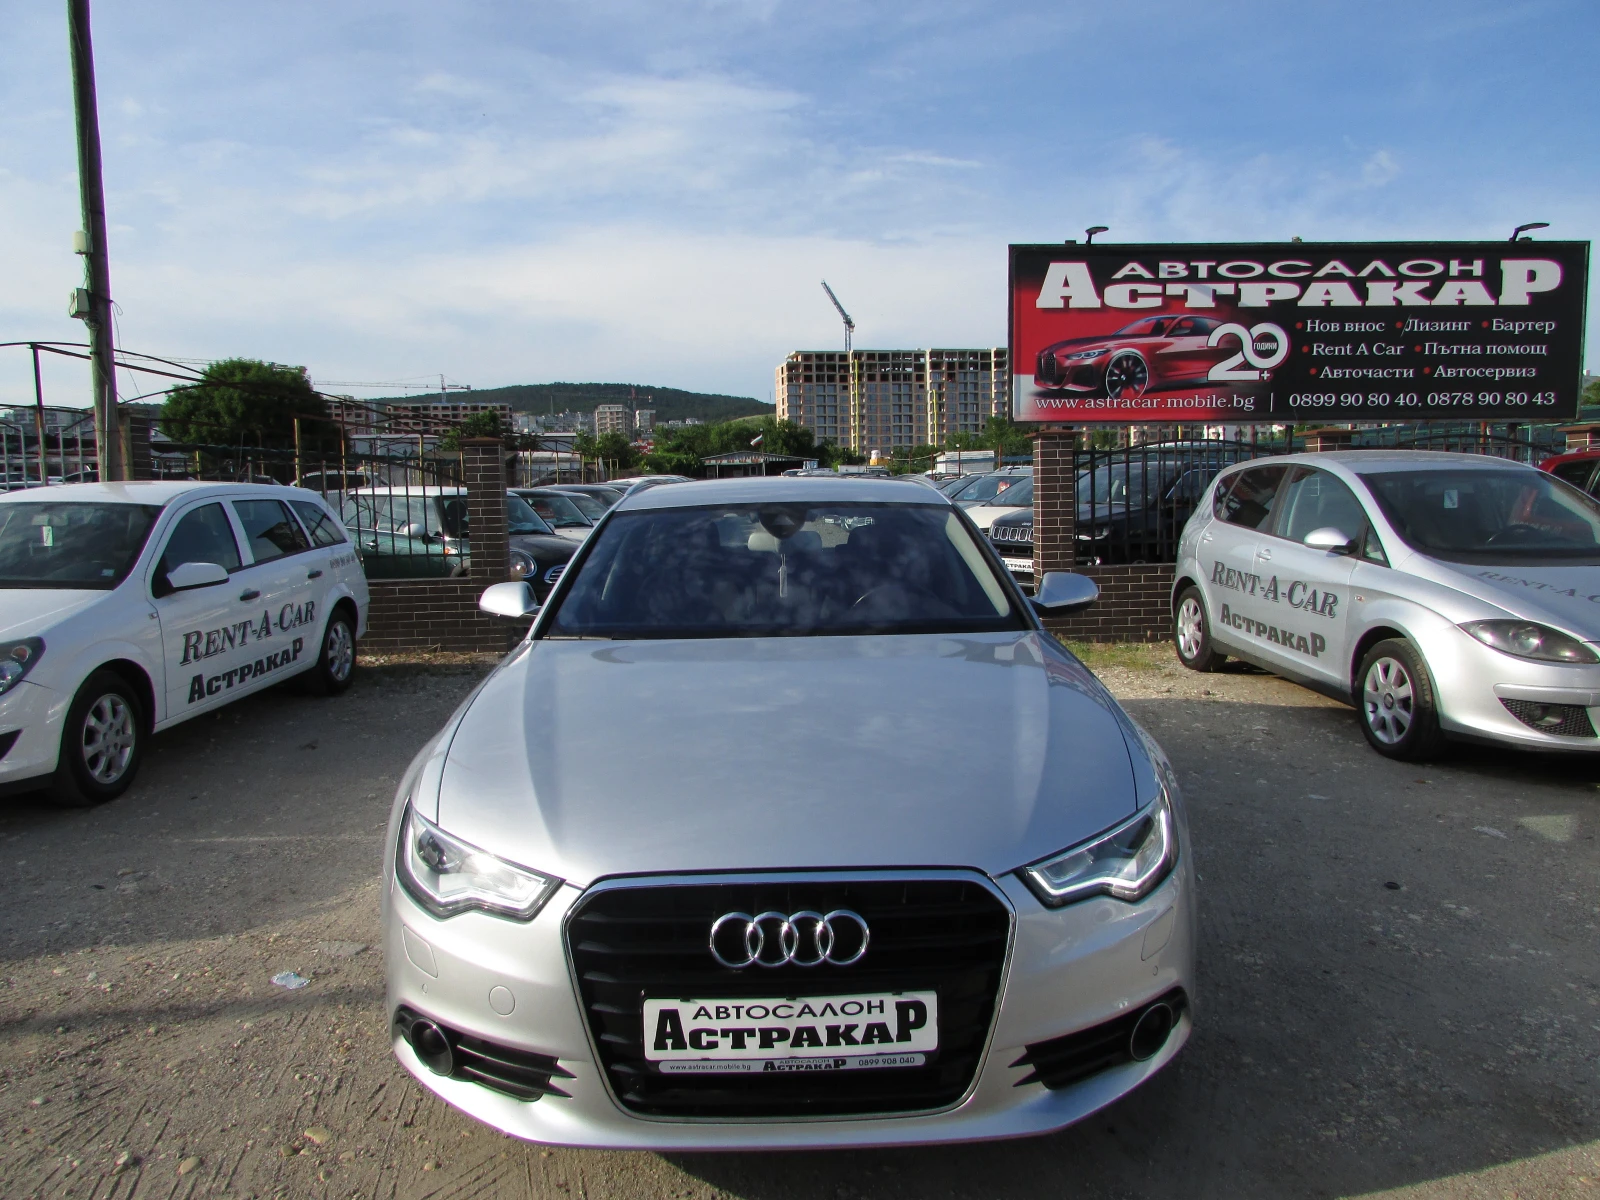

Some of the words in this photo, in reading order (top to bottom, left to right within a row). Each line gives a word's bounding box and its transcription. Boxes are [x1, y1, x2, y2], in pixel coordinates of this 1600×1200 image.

[1111, 260, 1483, 279] АВТОСАЛОН
[1305, 319, 1340, 332] Нов
[1344, 321, 1385, 332] внос
[1404, 319, 1471, 332] Лизинг
[1491, 318, 1555, 334] Бартер
[1311, 343, 1353, 356] Rent
[1355, 343, 1370, 355] A
[1372, 343, 1404, 355] Car
[1423, 343, 1482, 355] Пътна
[1484, 345, 1547, 357] помощ
[1319, 366, 1415, 378] Авточасти
[1433, 365, 1536, 380] Автосервиз
[1035, 394, 1255, 411] www.astracar.mobile.bg
[1289, 393, 1336, 407] 0899
[1340, 393, 1363, 406] 90
[1367, 393, 1390, 406] 80
[1427, 392, 1473, 406] 0878
[1477, 392, 1500, 405] 90
[1504, 392, 1528, 405] 80
[1531, 392, 1555, 405] 43
[1211, 560, 1338, 618] RENT-A-CAR
[179, 600, 316, 667] RENT-A-CAR
[692, 1000, 885, 1020] АВТОСАЛОН
[858, 1058, 880, 1066] 0899
[882, 1058, 897, 1066] 908
[899, 1056, 915, 1065] 040
